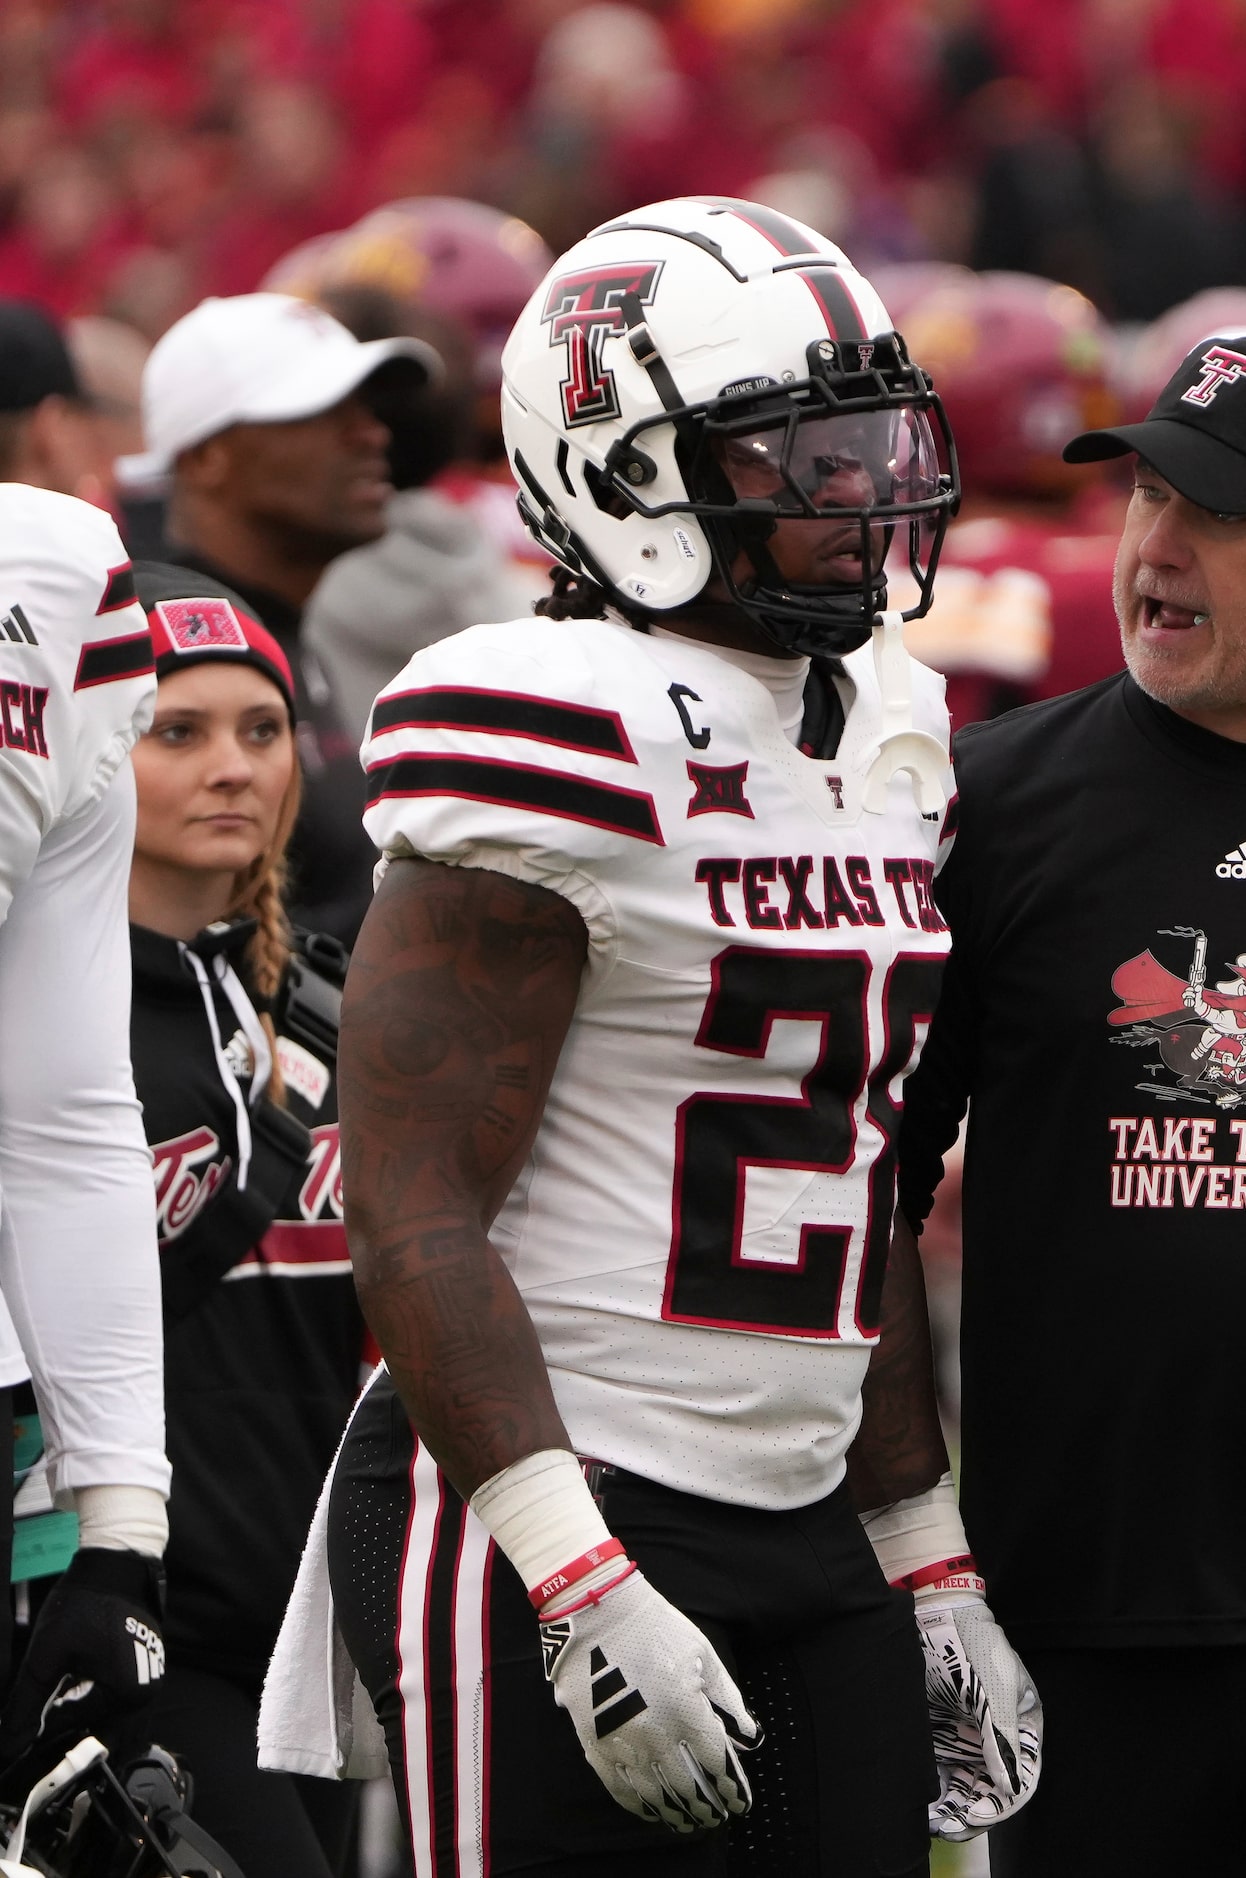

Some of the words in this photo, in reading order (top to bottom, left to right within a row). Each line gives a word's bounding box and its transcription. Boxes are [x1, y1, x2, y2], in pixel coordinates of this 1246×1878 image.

[667, 682, 711, 750] C
[694, 855, 886, 930] TEXAS
[1108, 1116, 1217, 1162] TAKE
[541, 1573, 569, 1598] ATFA
[933, 1577, 971, 1590] WRECK
